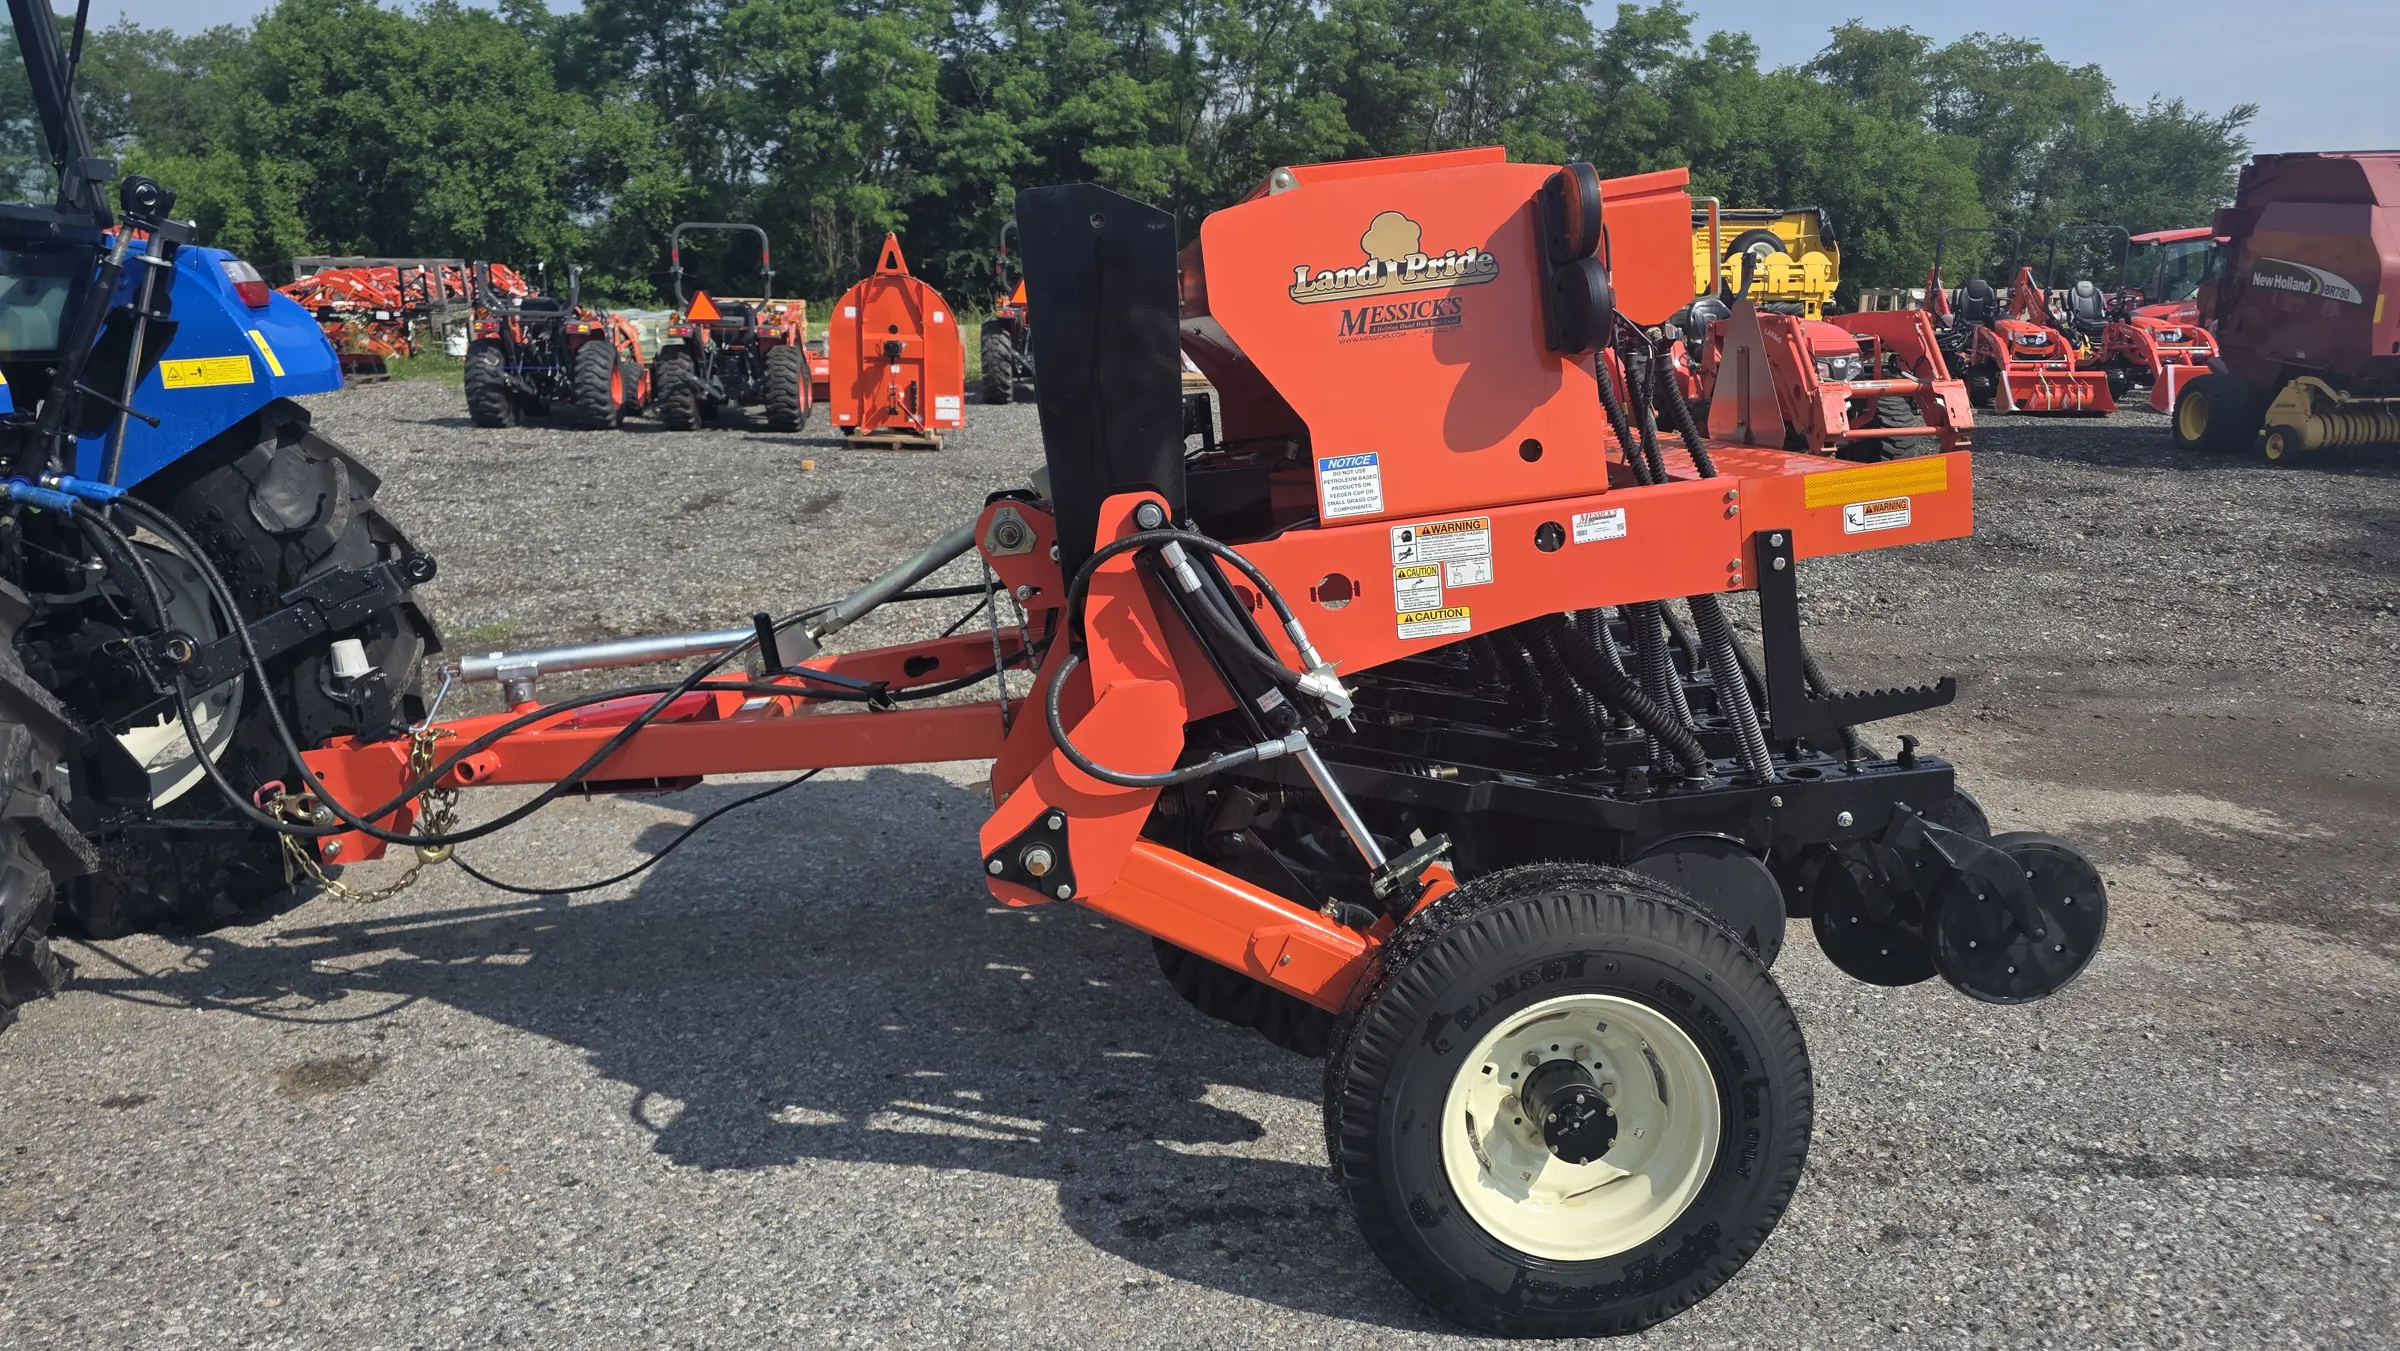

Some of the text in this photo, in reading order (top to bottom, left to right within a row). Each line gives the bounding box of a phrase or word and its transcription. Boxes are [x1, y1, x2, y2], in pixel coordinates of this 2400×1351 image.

[1294, 247, 1494, 293] Land Pride
[2253, 272, 2274, 287] New
[2274, 275, 2312, 293] Holland
[1338, 297, 1462, 337] MESSICK'S
[1377, 323, 1399, 334] Helping
[1400, 322, 1415, 330] Hand
[1328, 455, 1371, 469] NOTICE
[1323, 476, 1357, 485] PETROLEUM
[1331, 483, 1361, 491] PRODUCTS
[1330, 491, 1352, 499] FEEDER
[1327, 499, 1345, 507] SMALL
[1333, 503, 1373, 513] COMPONENTS.
[1873, 500, 1907, 512] WARNING
[1431, 520, 1480, 533] WARNING
[1406, 566, 1437, 577] CAUTION
[1415, 608, 1463, 621] CAUTION
[1455, 956, 1588, 1032] SAMSON
